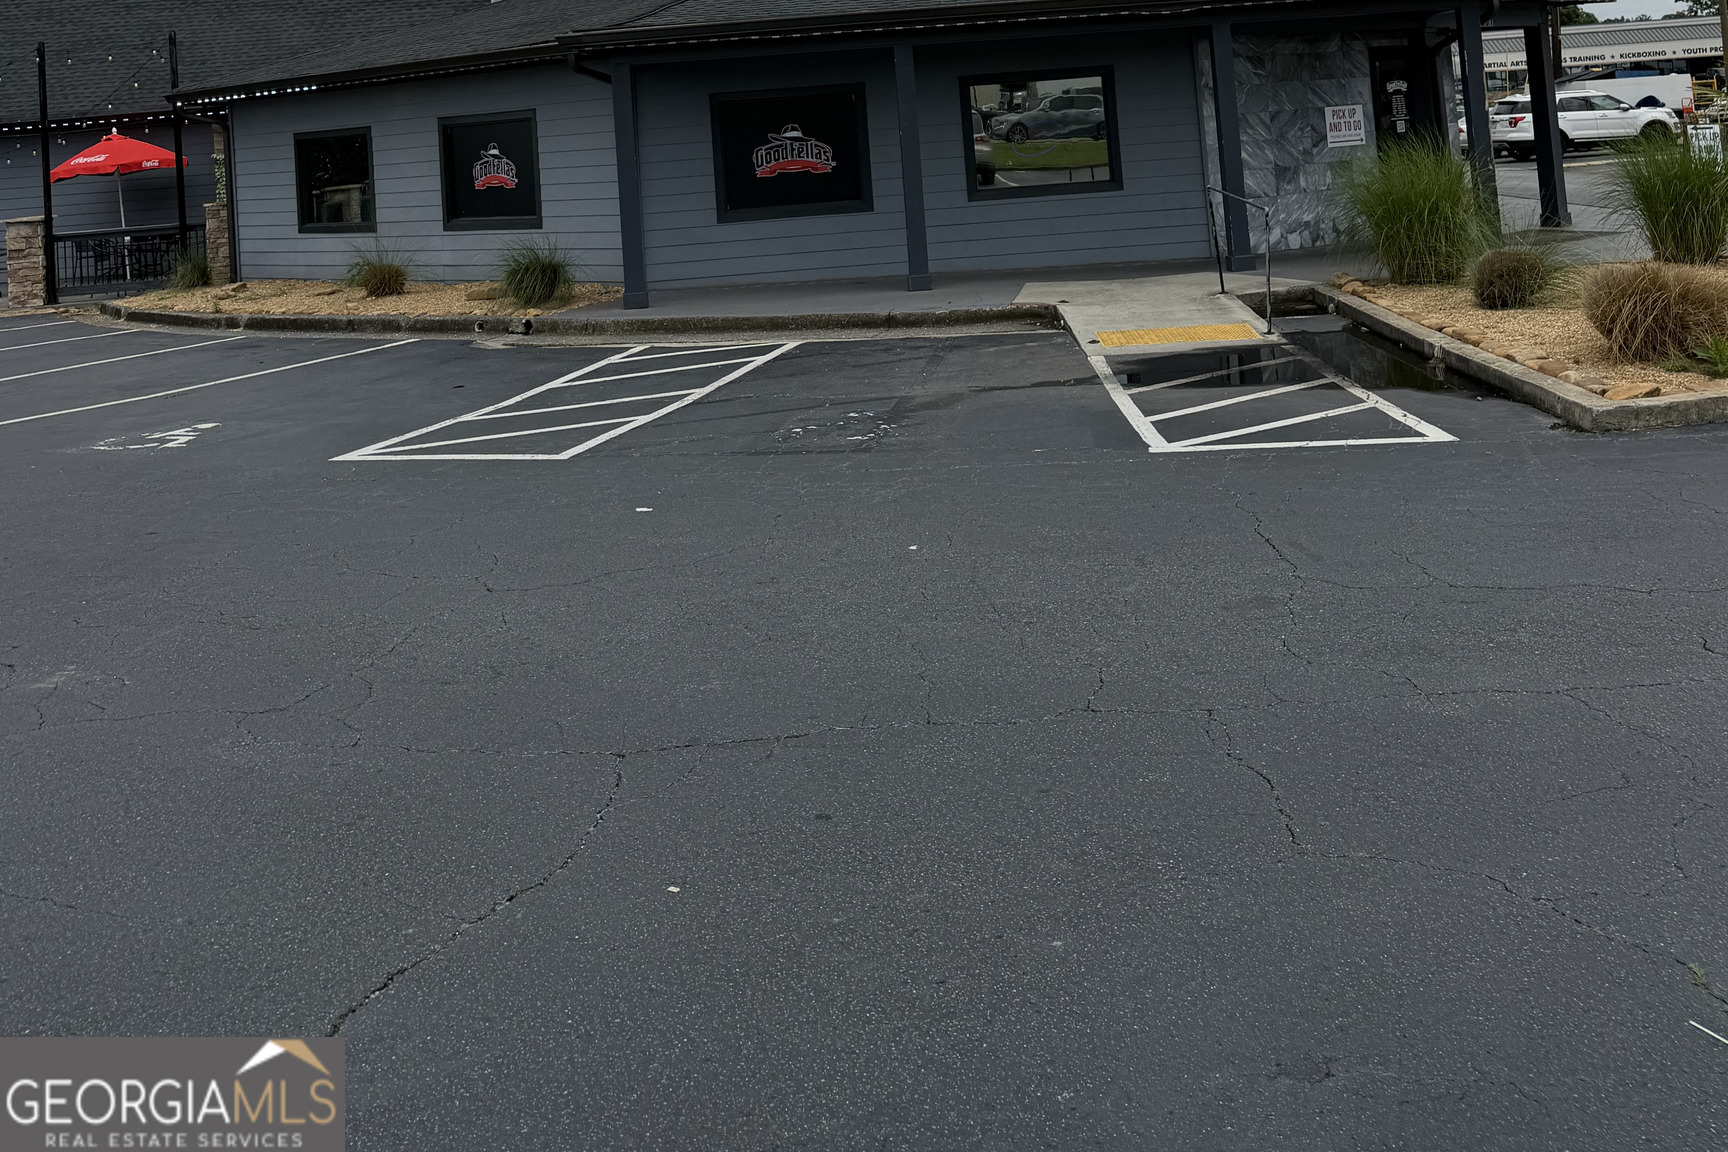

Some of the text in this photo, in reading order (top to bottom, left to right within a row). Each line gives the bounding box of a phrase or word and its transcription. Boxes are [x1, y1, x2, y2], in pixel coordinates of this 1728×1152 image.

[1569, 54, 1606, 63] TRAINING
[1620, 50, 1667, 59] KICKBOXING
[1484, 61, 1507, 69] ARTIAL
[1331, 107, 1357, 120] PICK UP
[1329, 119, 1362, 133] AND TO GO
